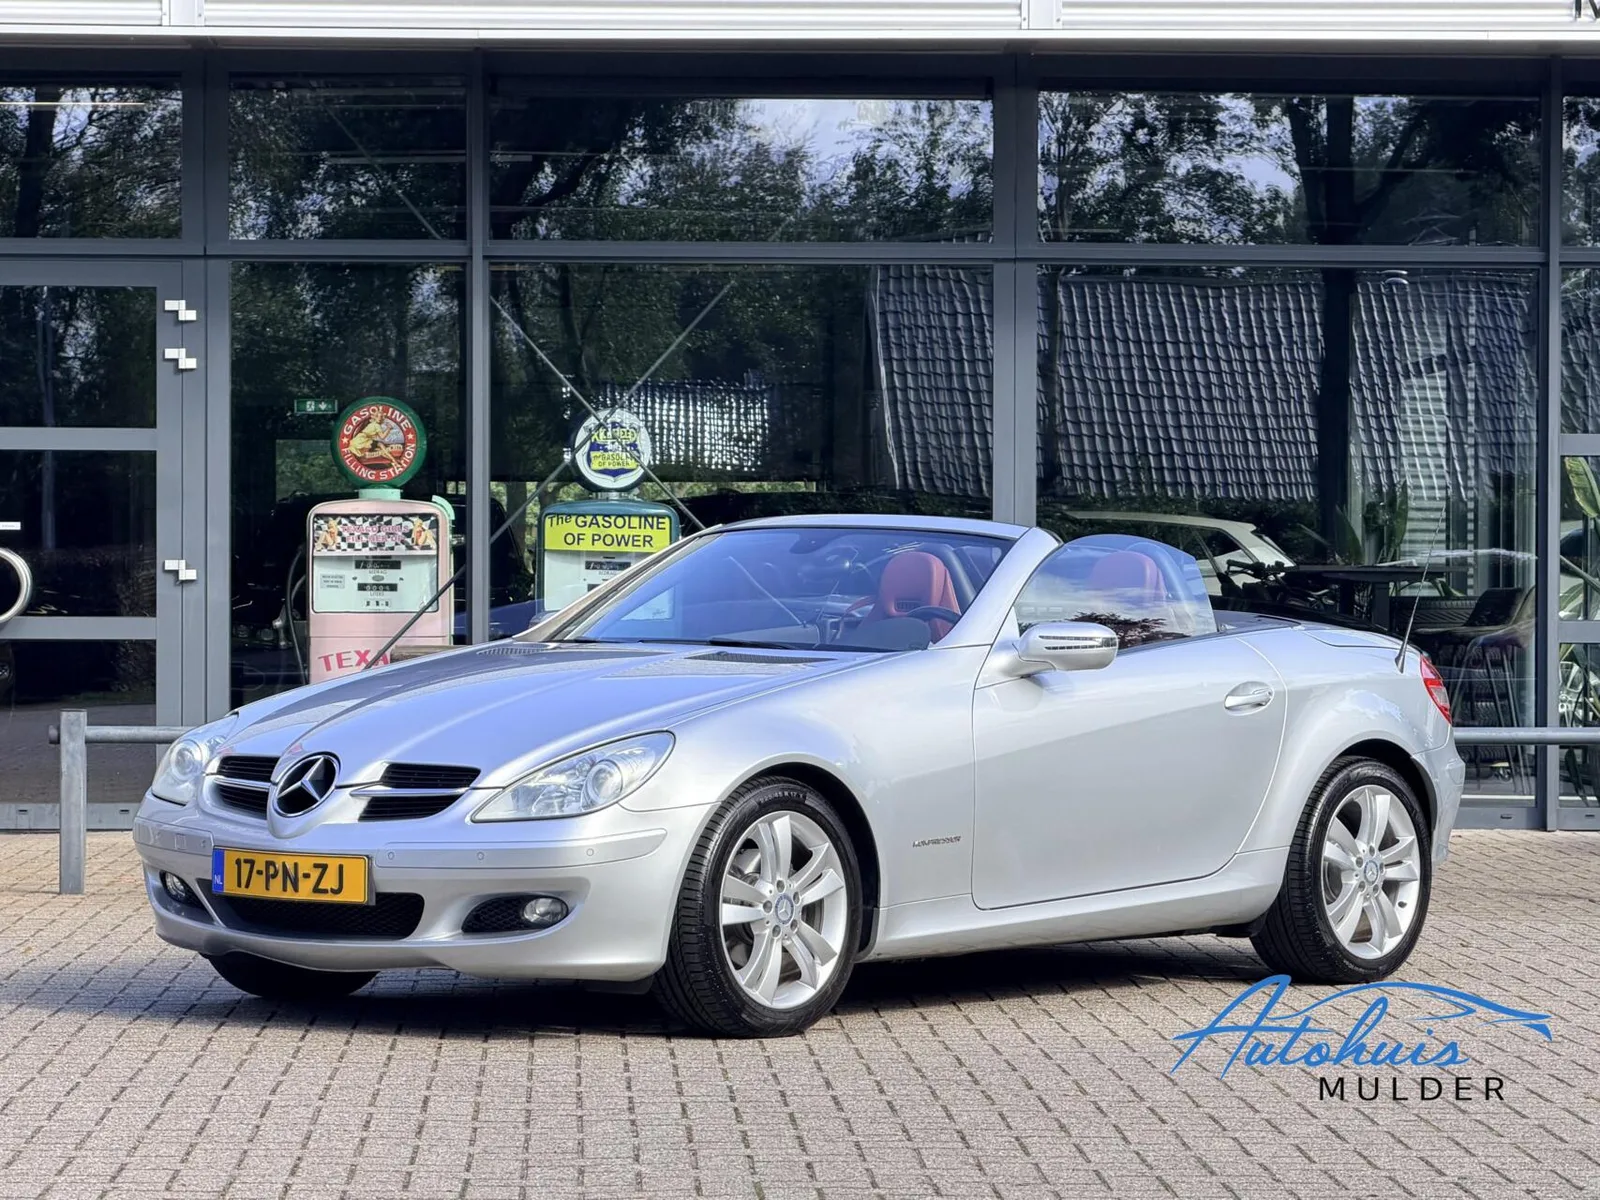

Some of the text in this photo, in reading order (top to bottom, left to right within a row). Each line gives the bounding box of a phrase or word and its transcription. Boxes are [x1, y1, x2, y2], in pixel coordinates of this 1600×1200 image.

[343, 406, 412, 435] GASOLINE
[341, 443, 416, 480] FILLING STATION
[548, 514, 667, 531] The GASOLINE
[563, 532, 654, 548] OF POWER
[214, 857, 344, 895] NL 17-PN-ZJ
